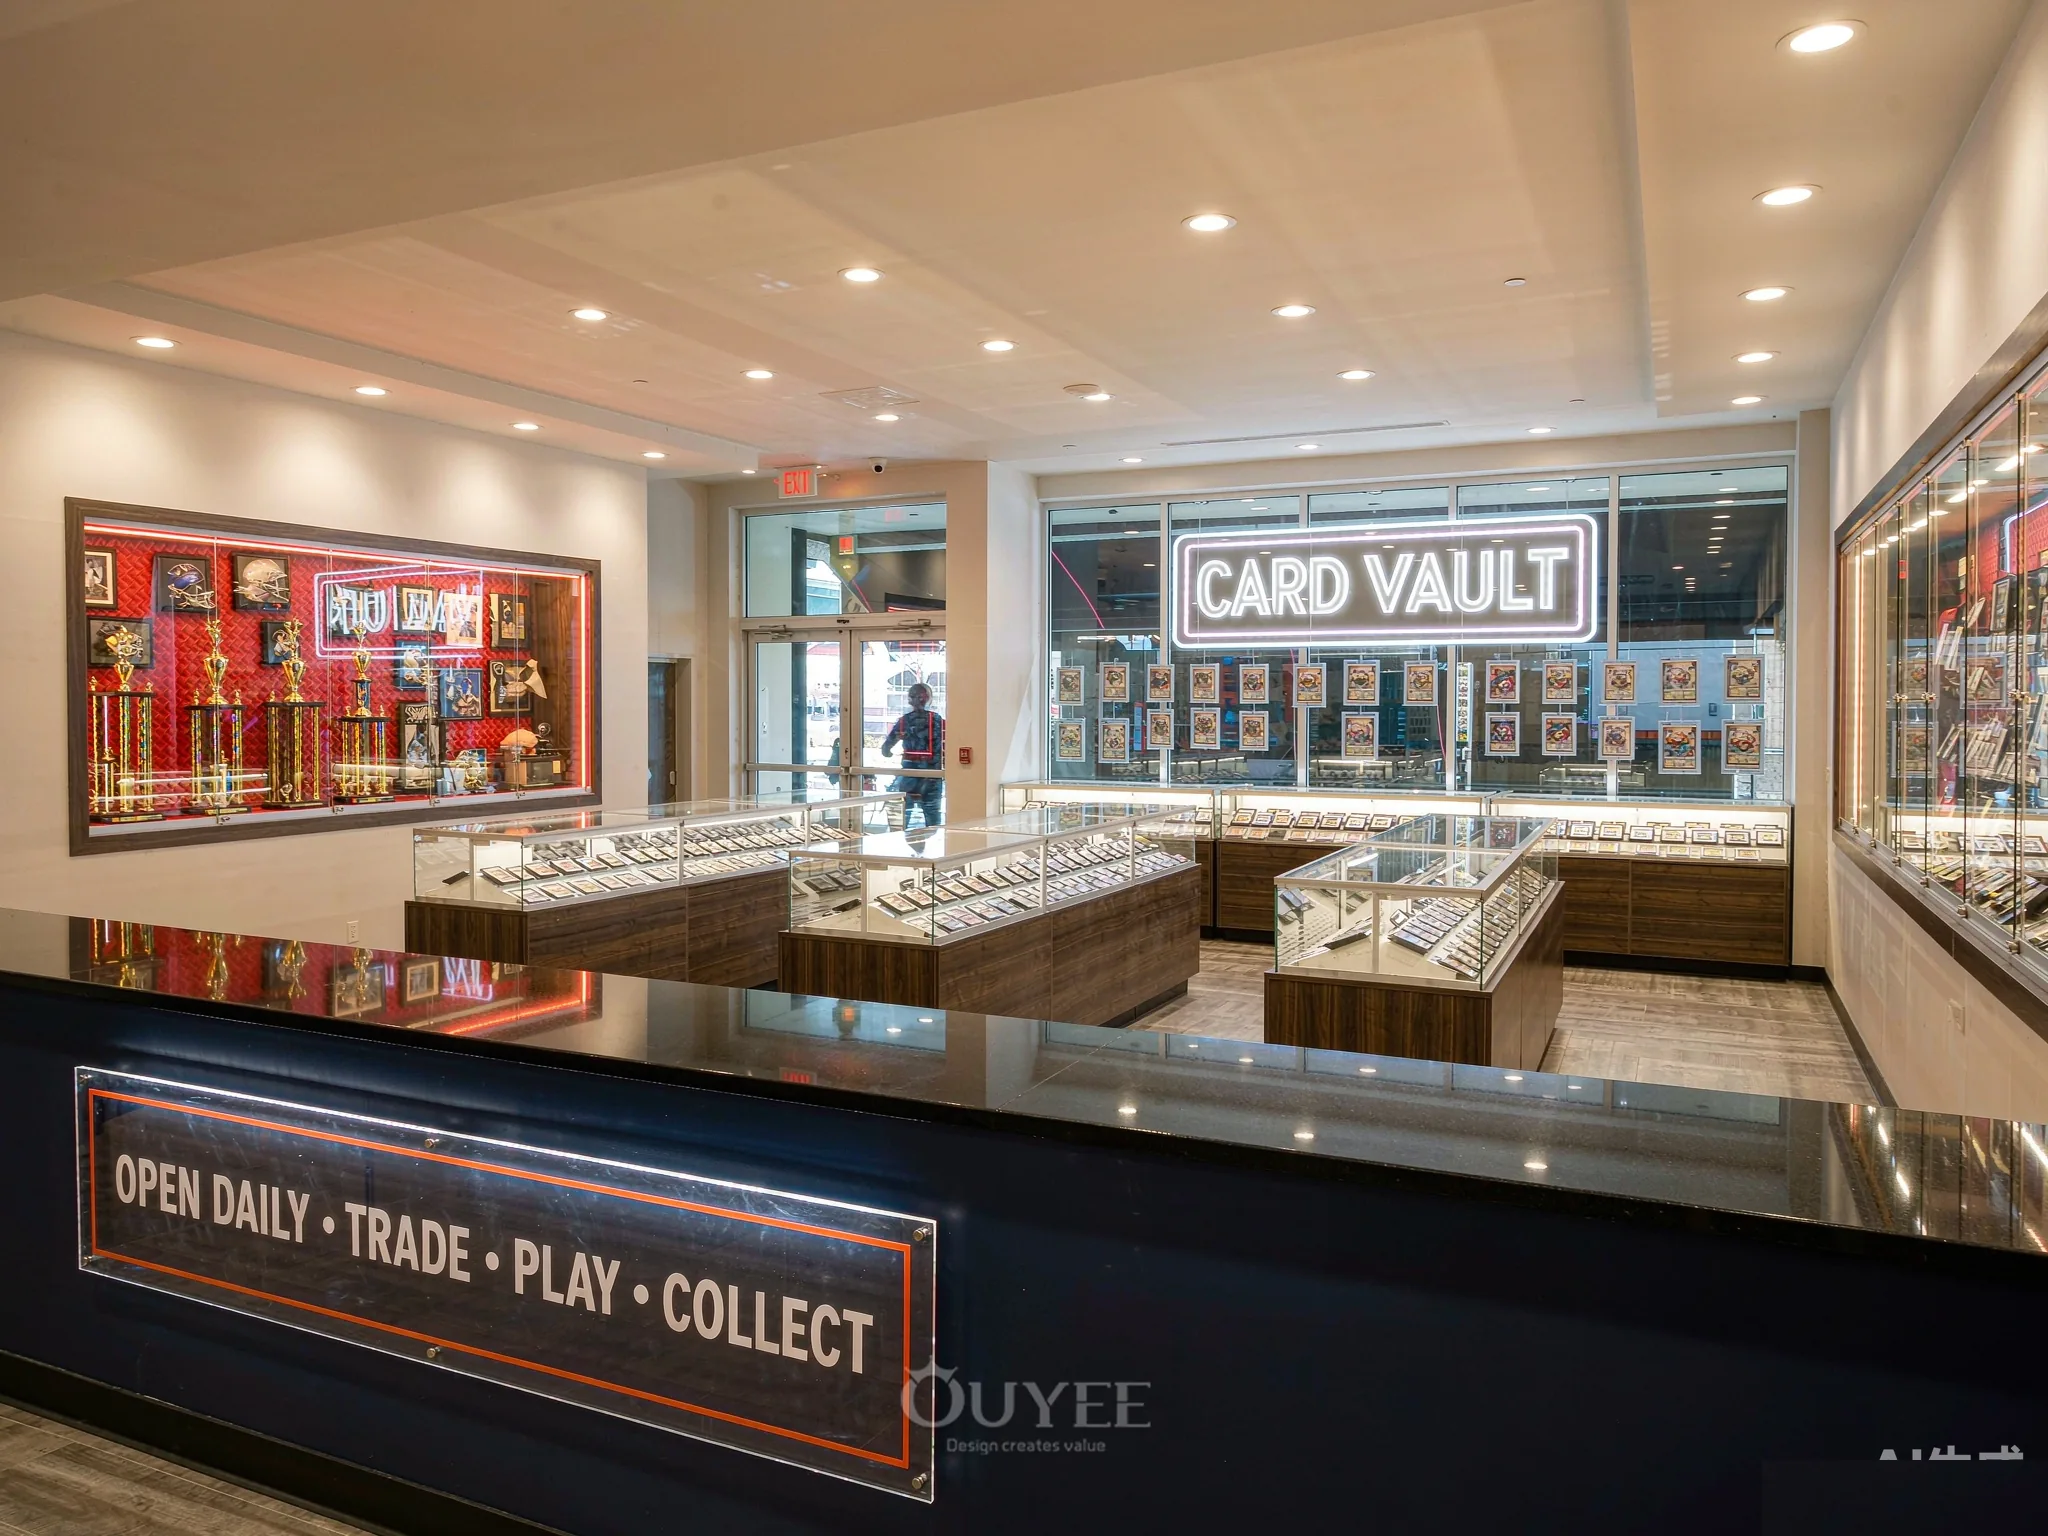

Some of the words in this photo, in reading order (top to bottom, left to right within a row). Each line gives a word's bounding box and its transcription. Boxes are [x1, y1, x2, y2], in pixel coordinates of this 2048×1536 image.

[783, 469, 812, 496] EXIT
[1195, 554, 1351, 619] CARD
[1362, 546, 1570, 615] VAULT
[115, 1153, 200, 1220] OPEN
[213, 1172, 311, 1244] DAILY
[344, 1201, 471, 1283] TRADE
[514, 1237, 621, 1316] PLAY
[662, 1272, 875, 1375] COLLECT
